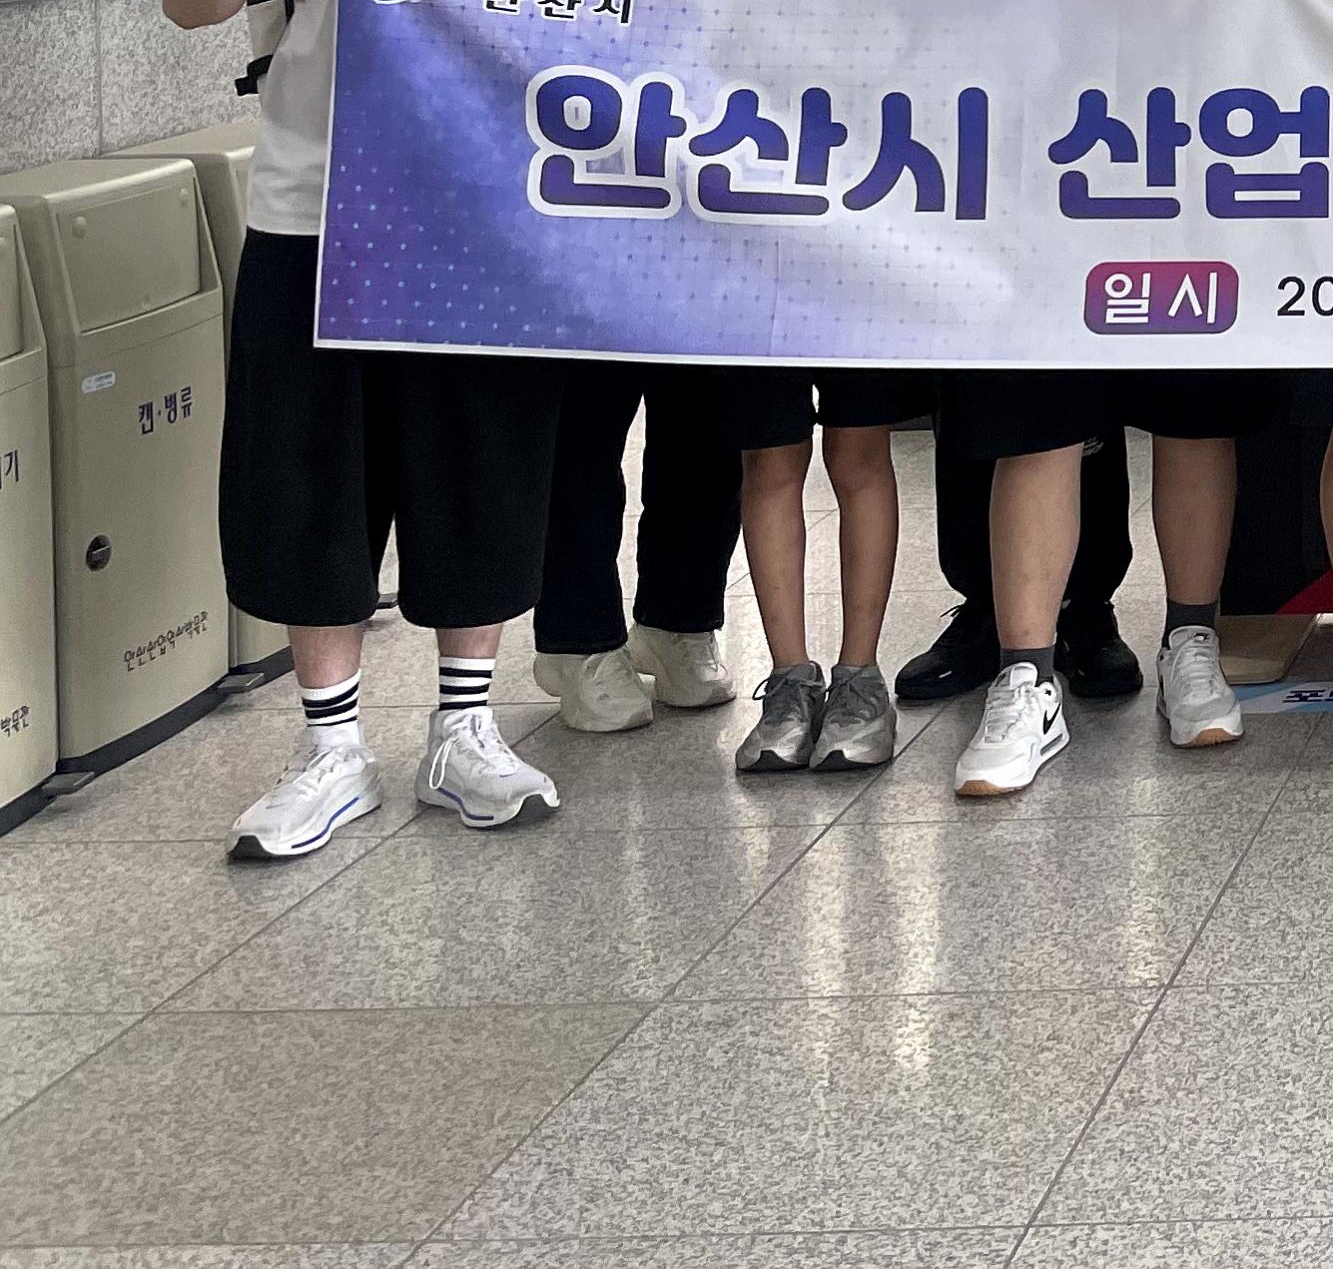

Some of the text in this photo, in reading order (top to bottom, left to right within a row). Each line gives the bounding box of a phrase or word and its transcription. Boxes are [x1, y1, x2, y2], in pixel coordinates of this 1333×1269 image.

[533, 73, 990, 221] 안산시
[1104, 271, 1219, 325] 일시
[124, 610, 208, 672] 안산산업역사박물관
